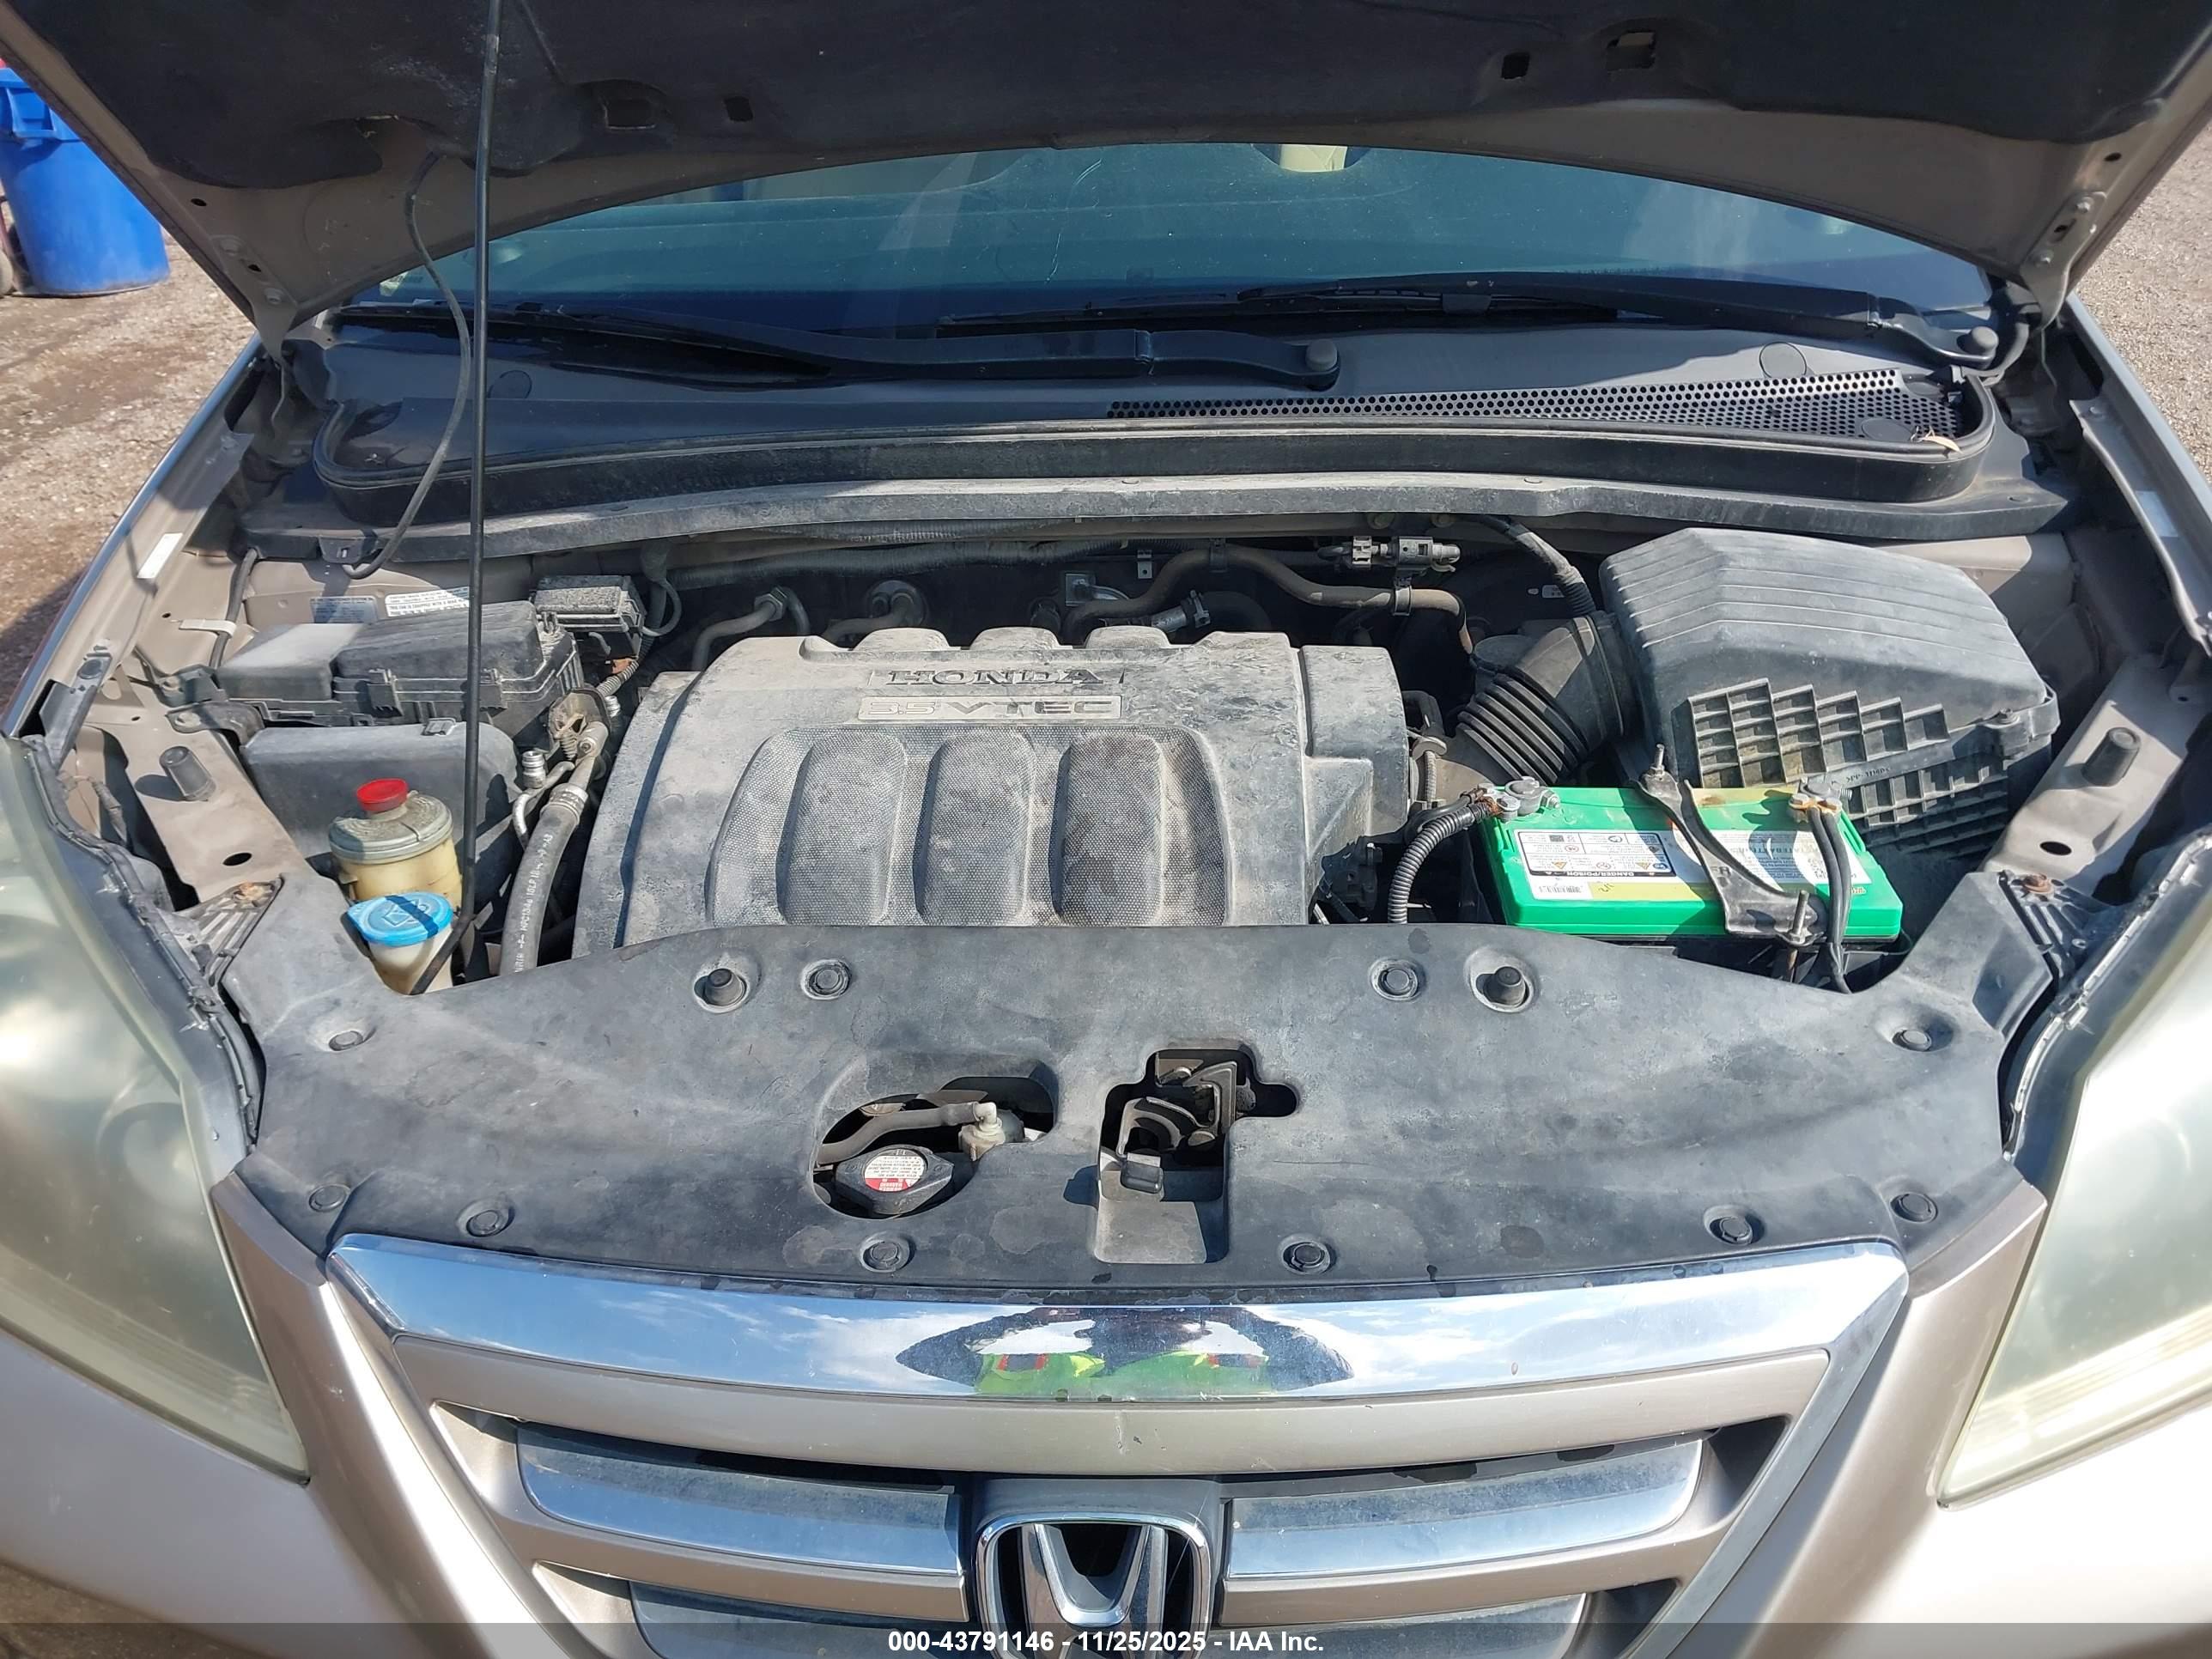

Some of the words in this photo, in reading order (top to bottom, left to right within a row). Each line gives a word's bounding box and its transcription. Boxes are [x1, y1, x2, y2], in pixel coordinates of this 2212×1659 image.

[885, 669, 1104, 685] HONDA
[867, 701, 936, 715] 3.5
[947, 700, 1113, 715] VTEC
